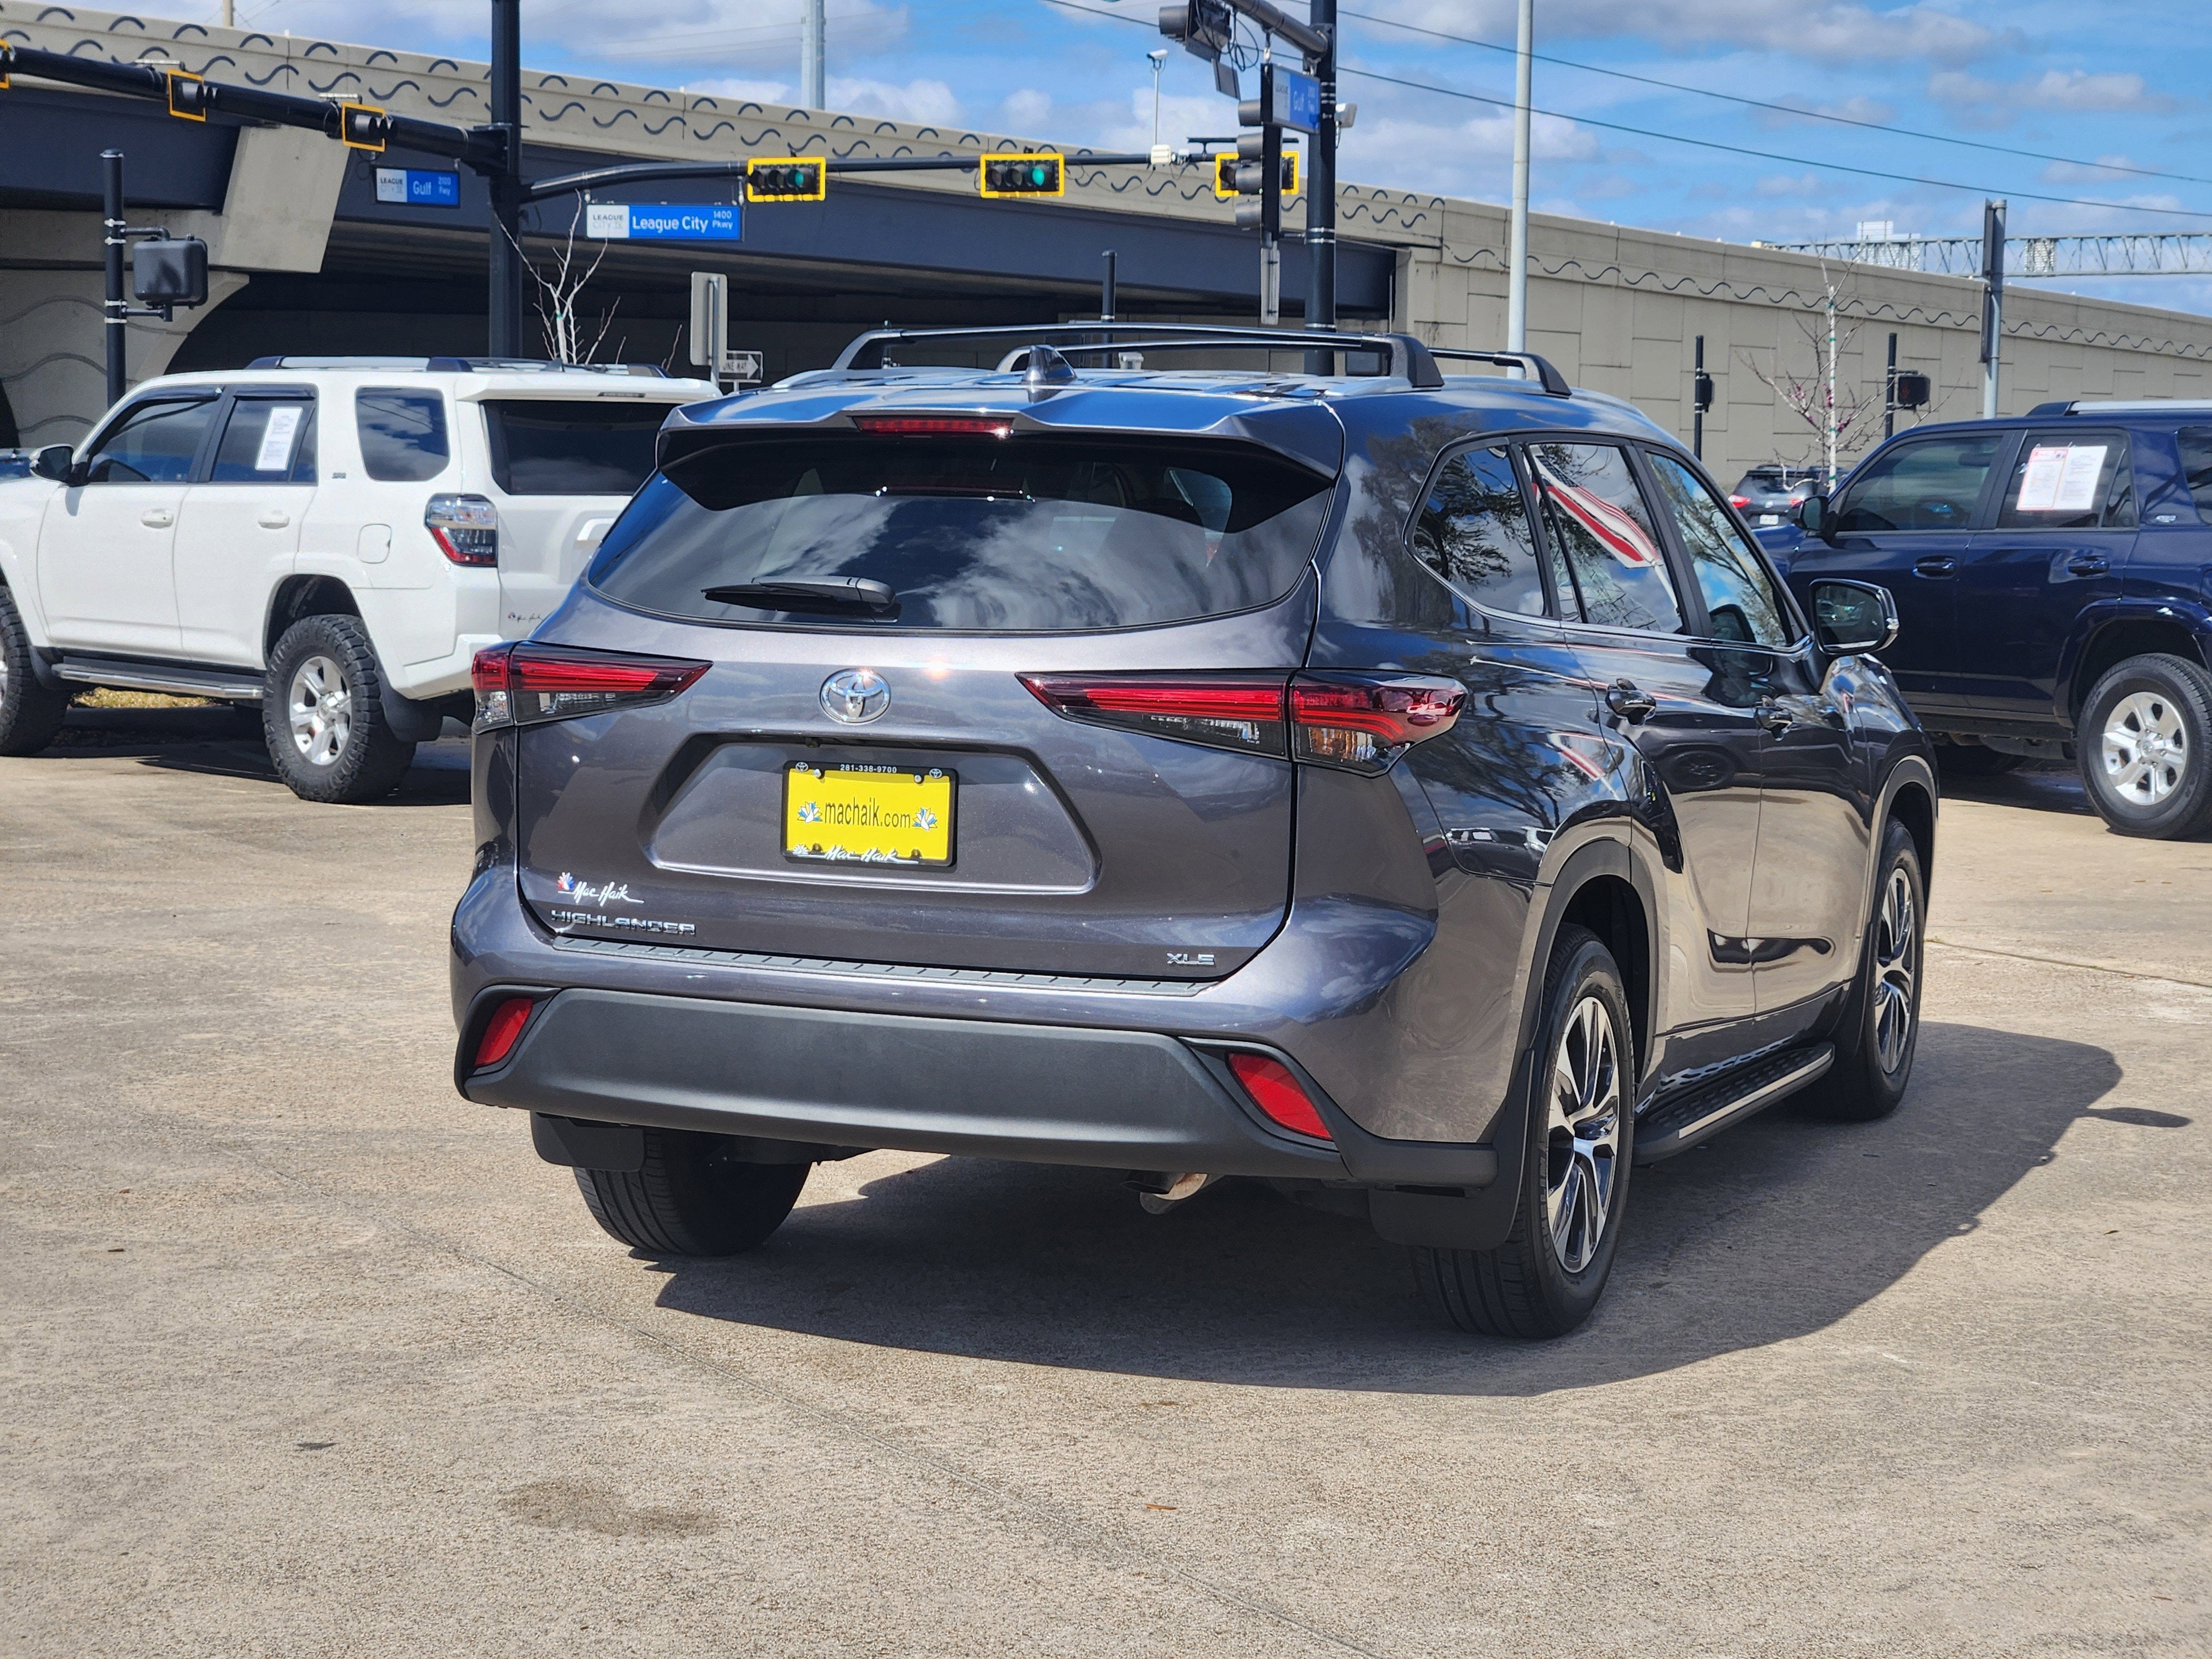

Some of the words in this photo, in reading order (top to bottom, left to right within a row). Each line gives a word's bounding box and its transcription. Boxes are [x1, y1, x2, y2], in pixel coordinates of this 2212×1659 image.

[413, 180, 431, 195] Gulf
[713, 210, 732, 220] 1400
[632, 216, 680, 234] League
[681, 216, 709, 234] City
[712, 220, 733, 230] Pkwy
[840, 764, 898, 774] 281-338-9700
[824, 796, 911, 829] machaik.com
[823, 844, 856, 861] Mac
[860, 847, 907, 864] Haik
[570, 881, 599, 904] Mac
[598, 881, 636, 907] Haik
[551, 910, 697, 936] HIGHLANDER
[1166, 952, 1215, 966] XLE
